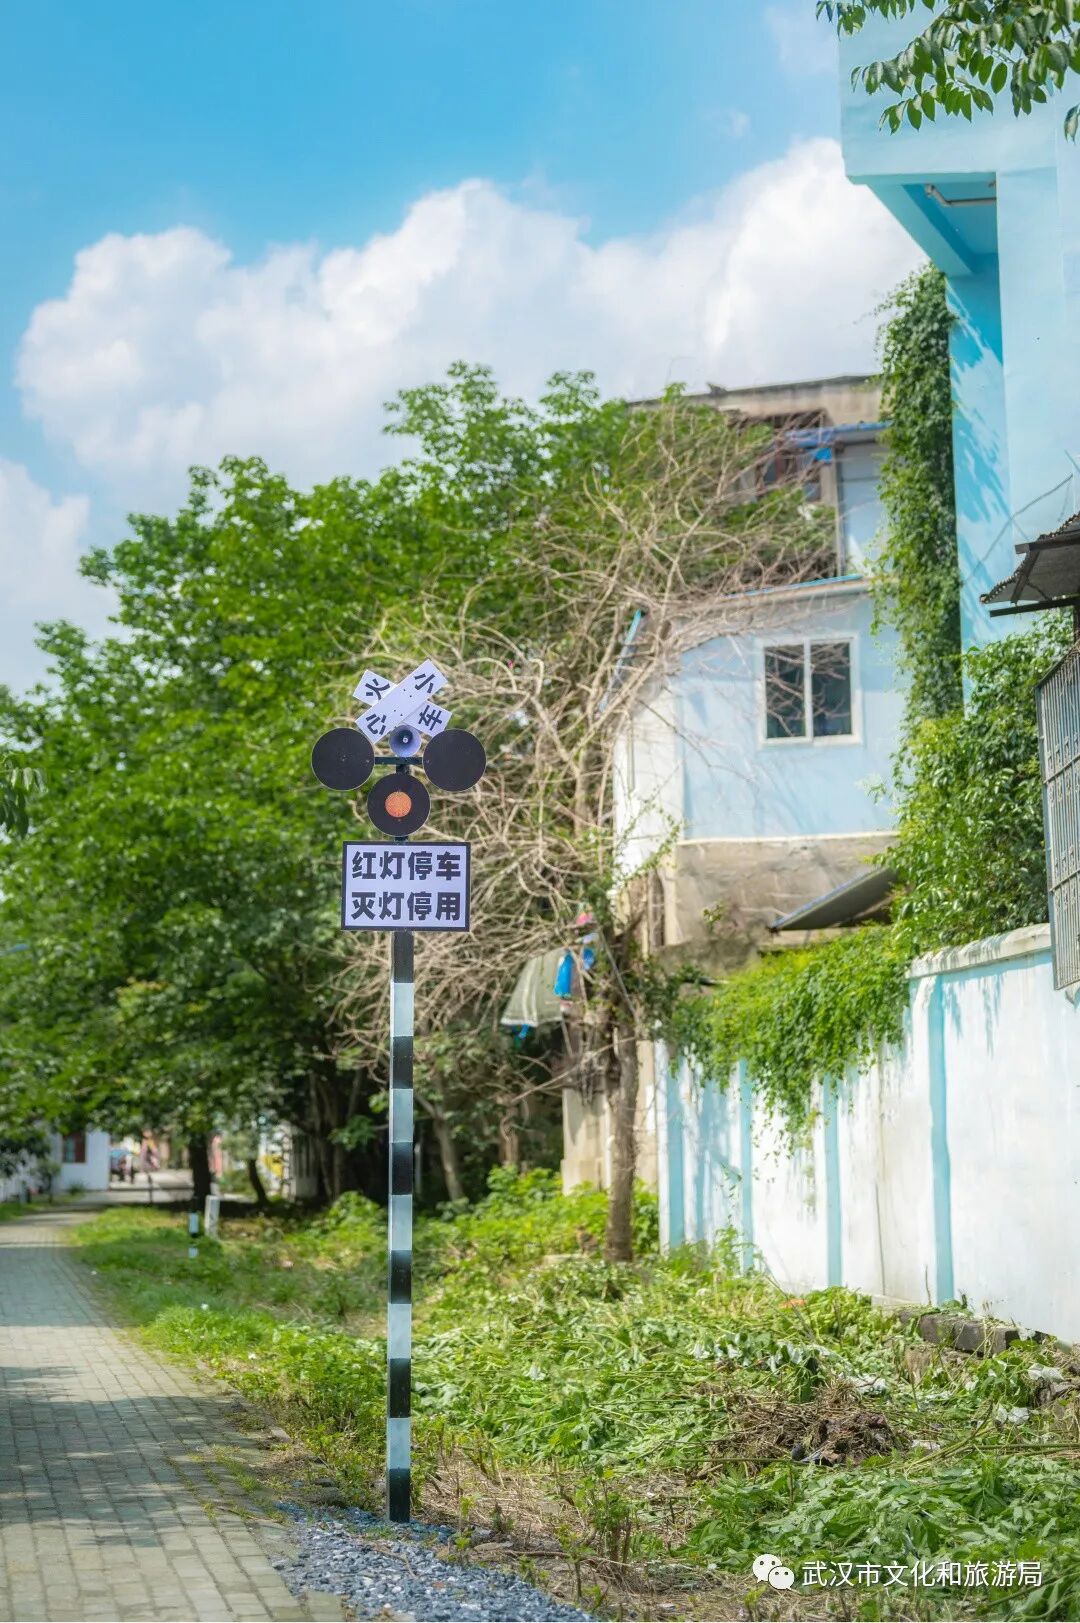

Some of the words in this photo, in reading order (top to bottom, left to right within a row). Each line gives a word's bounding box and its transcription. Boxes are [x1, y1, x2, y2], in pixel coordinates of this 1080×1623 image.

[351, 851, 461, 881] 红灯停车
[351, 891, 461, 921] 灭灯停用
